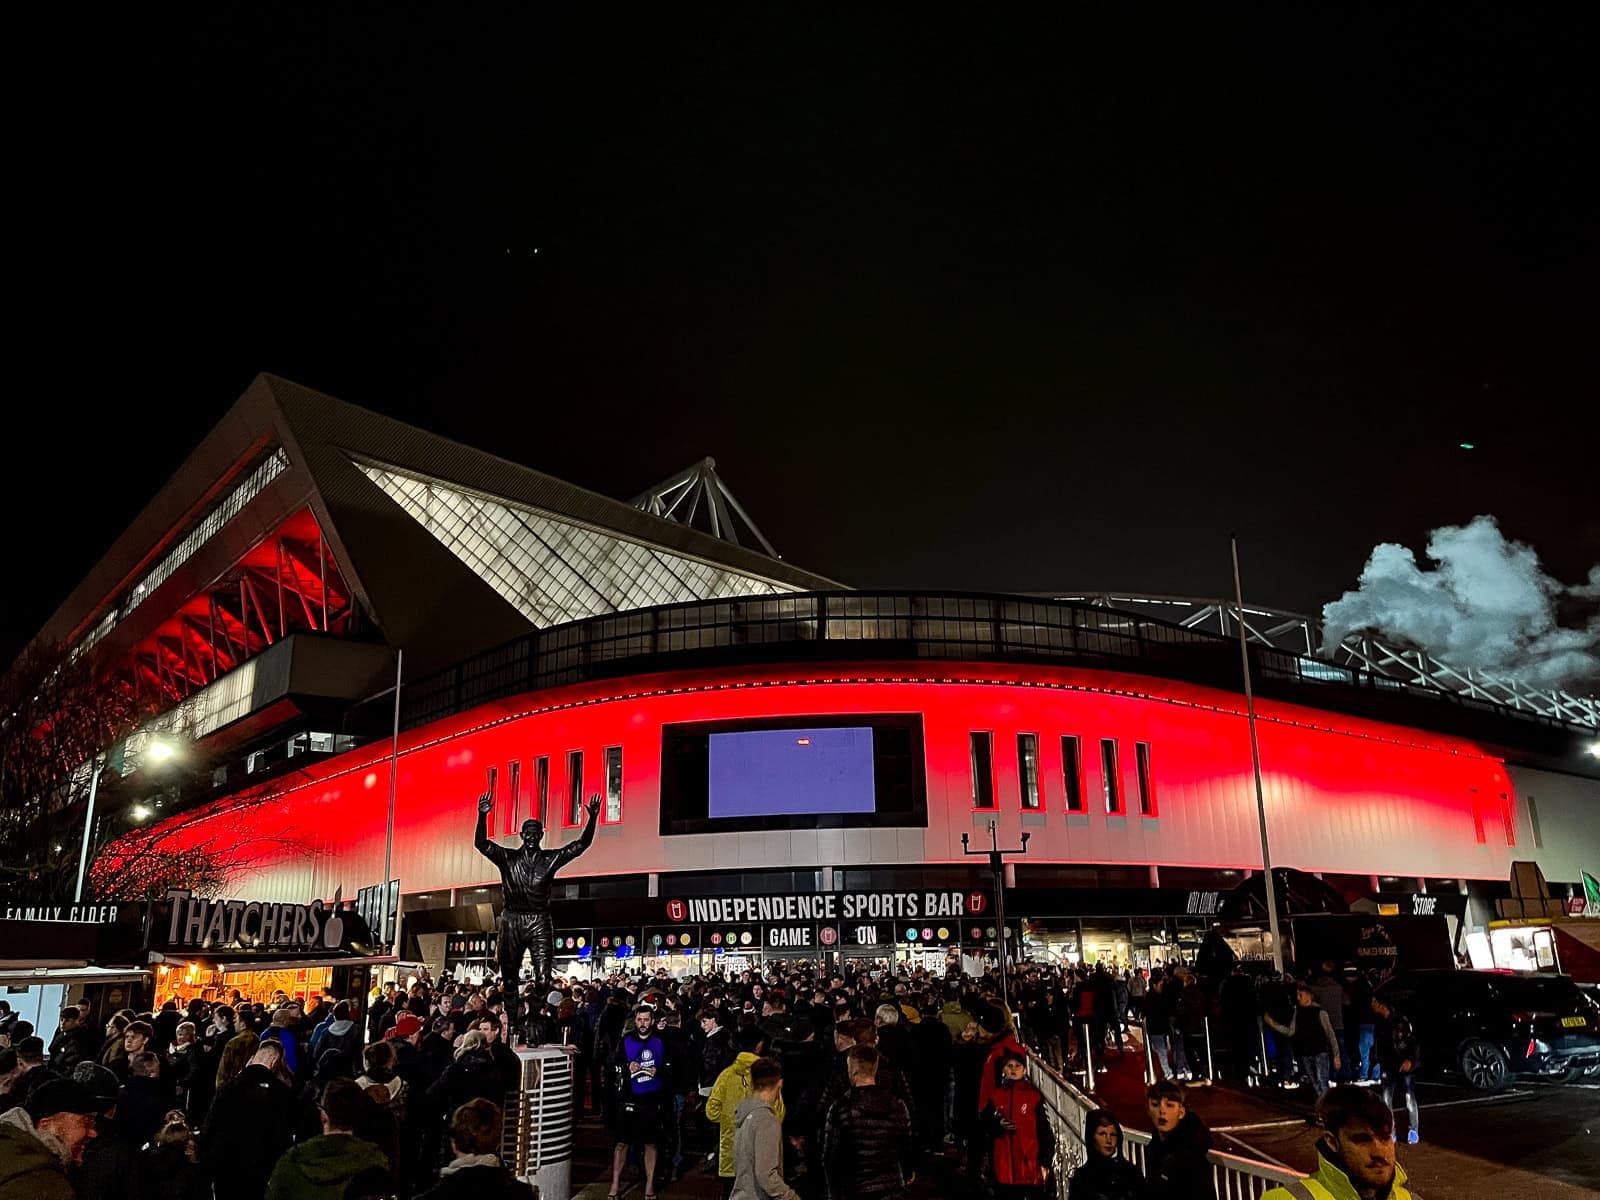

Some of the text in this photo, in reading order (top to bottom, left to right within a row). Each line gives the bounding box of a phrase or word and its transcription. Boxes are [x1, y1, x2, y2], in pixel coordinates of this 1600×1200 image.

[70, 905, 118, 923] CIDER
[167, 889, 324, 946] THATCHERS
[688, 892, 964, 922] INDEPENDENCE SPORTS BAR
[1413, 897, 1437, 916] STORE
[769, 925, 877, 947] GAME ON
